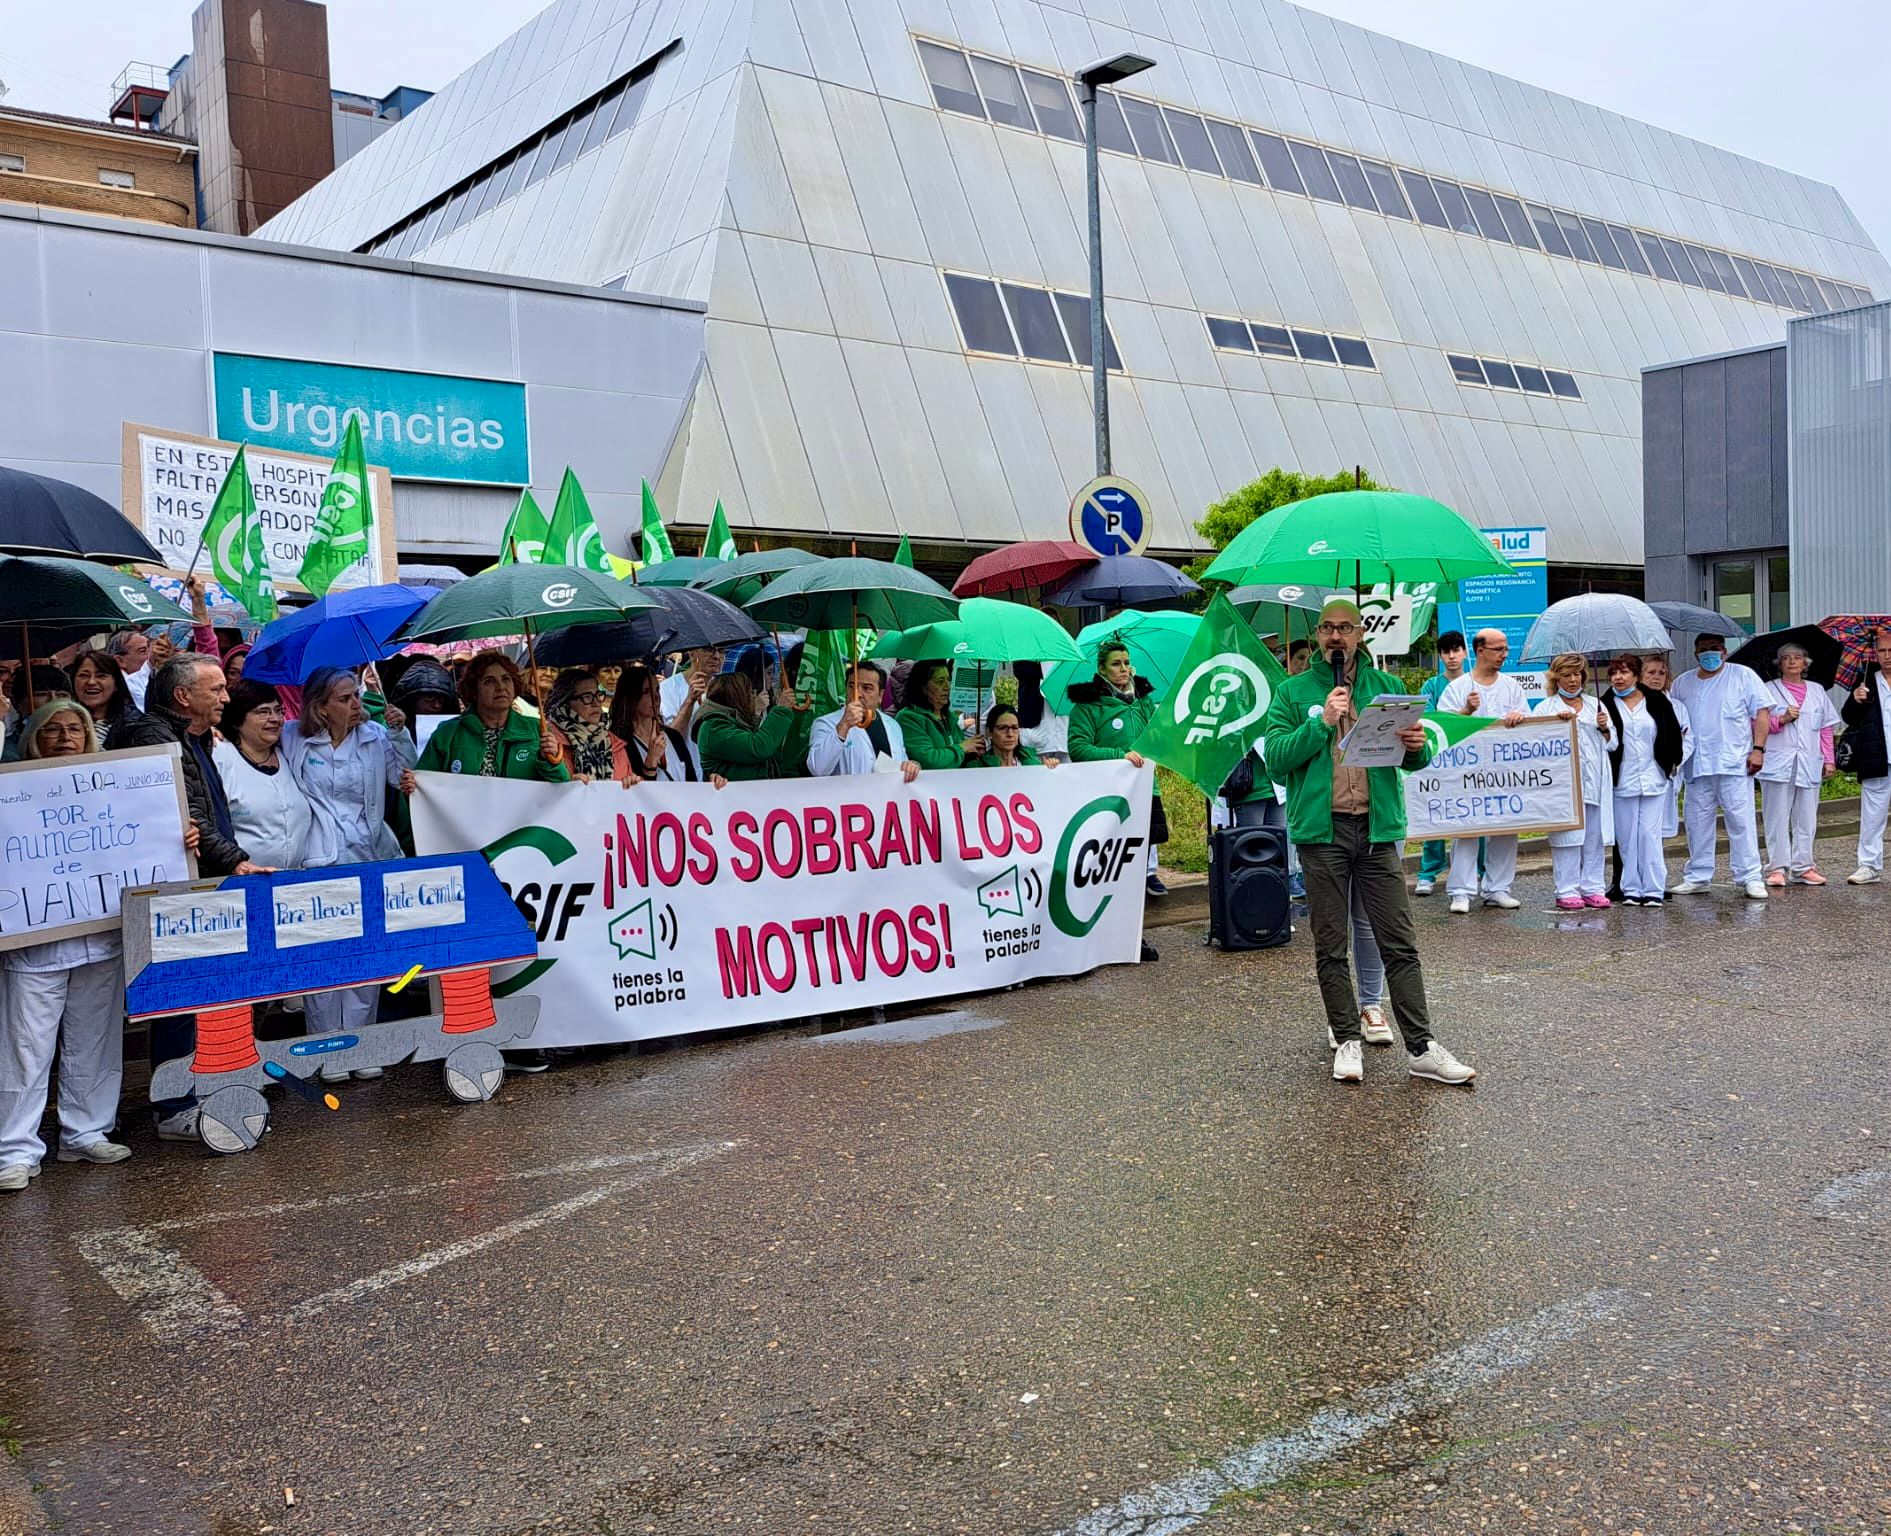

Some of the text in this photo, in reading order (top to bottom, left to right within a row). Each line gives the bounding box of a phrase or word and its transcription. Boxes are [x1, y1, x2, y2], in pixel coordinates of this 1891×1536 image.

[242, 387, 504, 450] Urgencias
[155, 447, 328, 488] EN EST HOSPIT
[156, 469, 326, 508] FALTA ERSON
[157, 496, 204, 520] MAS
[1107, 513, 1120, 533] P
[159, 528, 185, 547] NO
[1491, 533, 1530, 550] alud
[1431, 739, 1571, 769] OMOS PERSONAS
[47, 785, 65, 798] del
[1419, 769, 1553, 792] NO MÁQUINAS
[37, 804, 115, 828] POR el
[1428, 794, 1523, 822] RESPETO
[728, 797, 941, 882] SOBRAN
[952, 792, 1042, 860] LOS
[53, 860, 82, 874] de
[1073, 837, 1144, 888] CSIF
[312, 896, 360, 921] llevar
[983, 923, 1041, 943] tienes la
[715, 903, 955, 999] MOTIVOS!
[985, 938, 1040, 961] palabra
[613, 968, 683, 989] tienes la
[614, 987, 686, 1011] palabra
